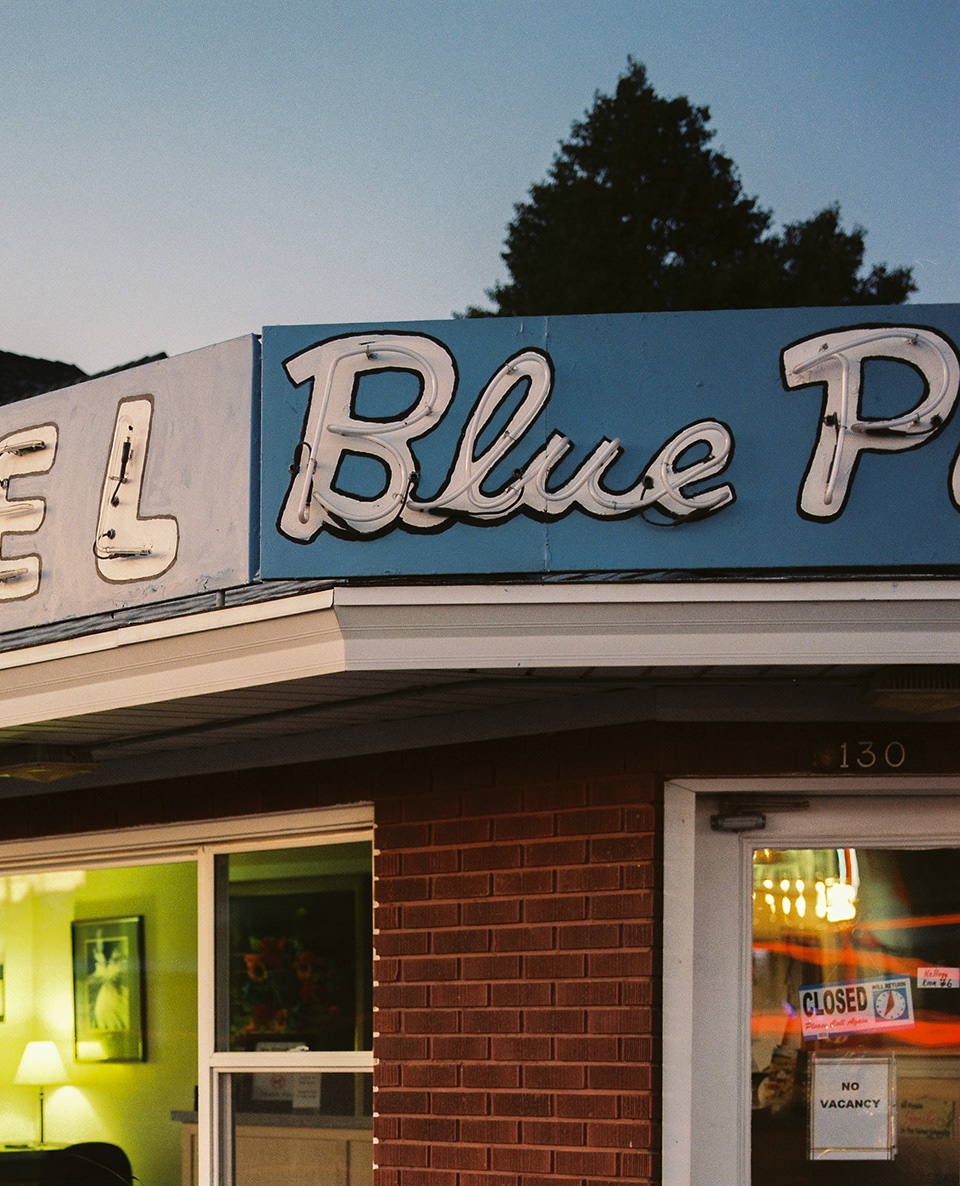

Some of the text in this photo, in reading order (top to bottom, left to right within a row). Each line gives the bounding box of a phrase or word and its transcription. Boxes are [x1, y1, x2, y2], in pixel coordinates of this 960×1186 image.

[275, 322, 960, 544] Blue P
[840, 741, 905, 768] 130
[885, 981, 907, 989] RETURN
[803, 986, 868, 1017] CLOSED
[805, 1017, 869, 1030] Please Call Again
[841, 1082, 860, 1091] NO
[820, 1100, 881, 1109] VACANCY
